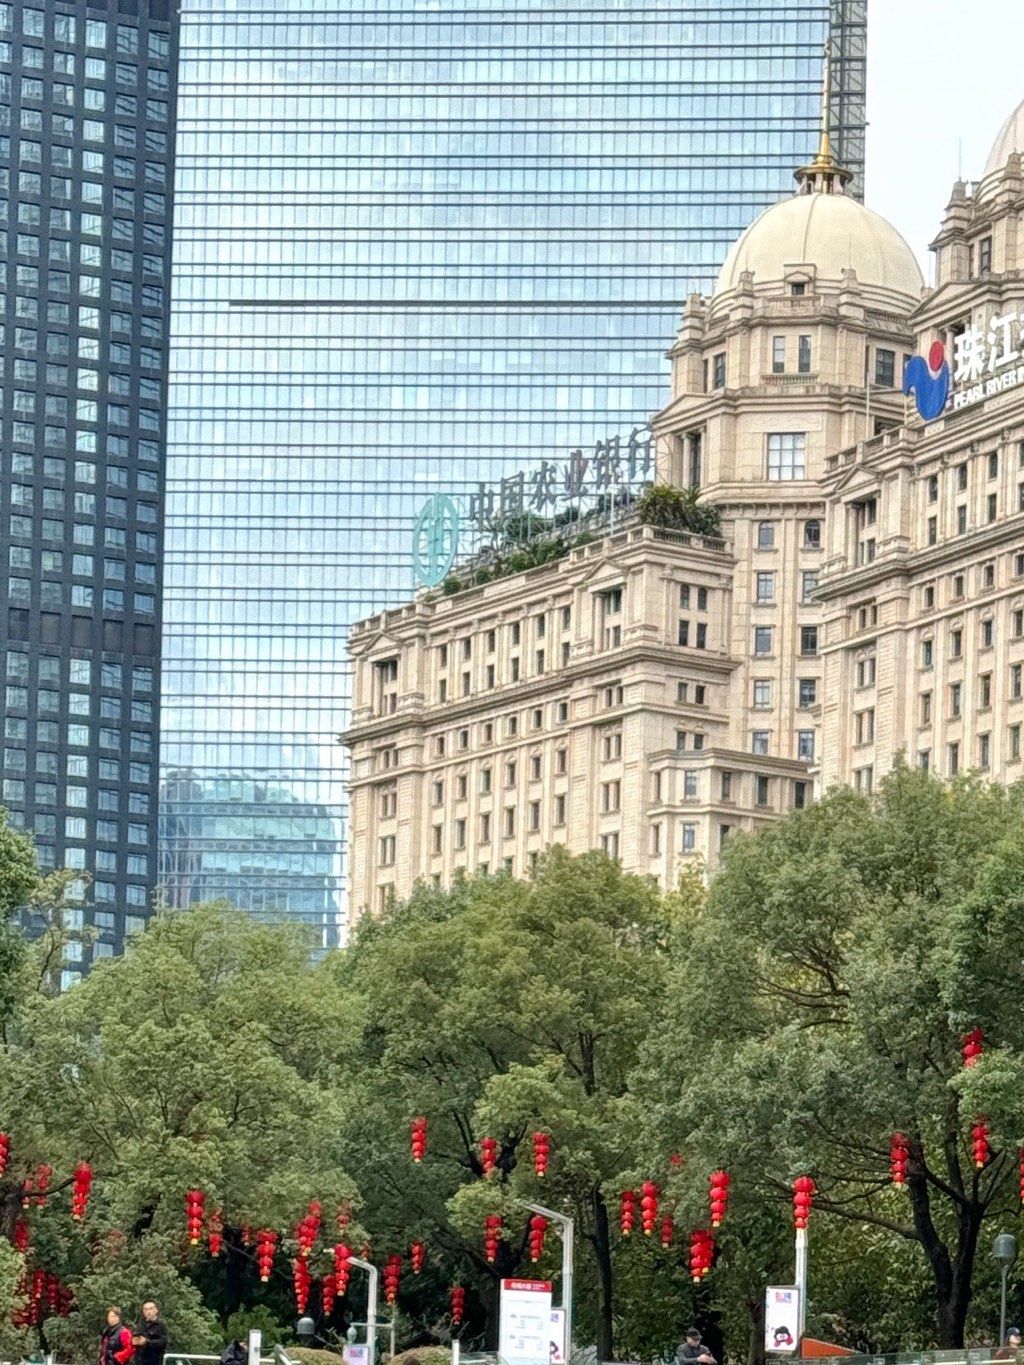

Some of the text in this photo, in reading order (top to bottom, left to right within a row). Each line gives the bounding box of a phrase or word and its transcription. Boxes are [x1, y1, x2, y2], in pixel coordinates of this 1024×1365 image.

[953, 383, 985, 410] PEARL
[986, 370, 1017, 400] RIVER
[469, 426, 655, 524] 中国农业银行
